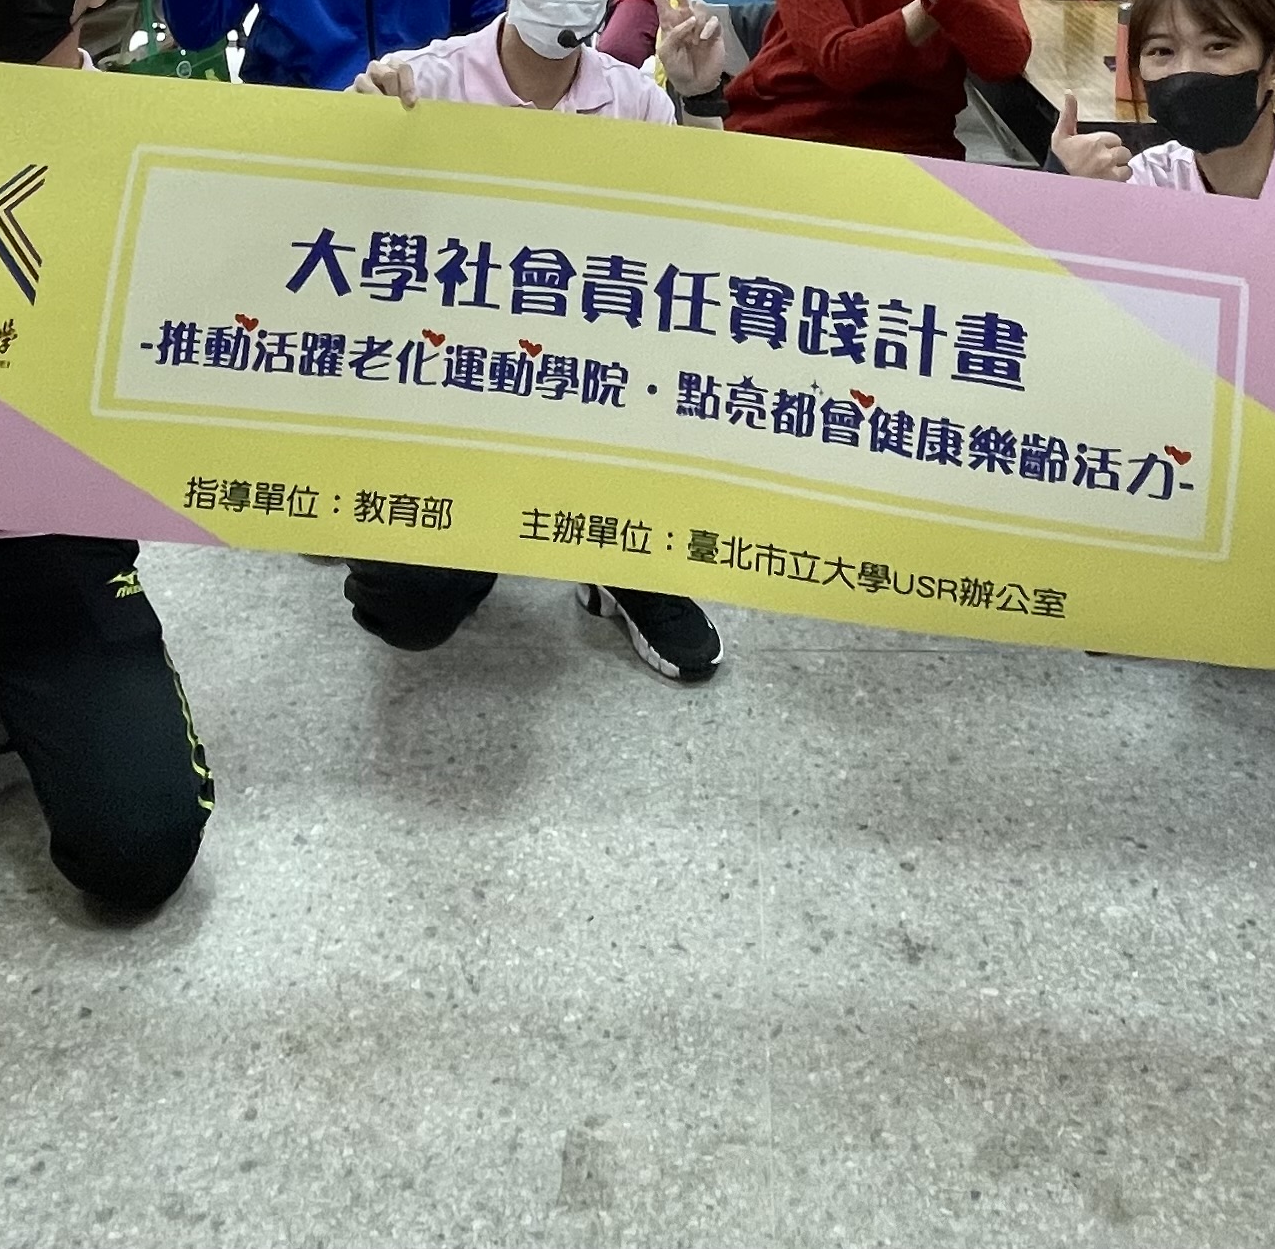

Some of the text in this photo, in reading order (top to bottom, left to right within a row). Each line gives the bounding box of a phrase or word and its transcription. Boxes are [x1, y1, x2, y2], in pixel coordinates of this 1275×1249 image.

[285, 228, 1028, 392] 大學社會責任實踐計畫
[183, 477, 1068, 620] 指導單位：教育部 主辦單位：臺北市立大學USR辦公室
